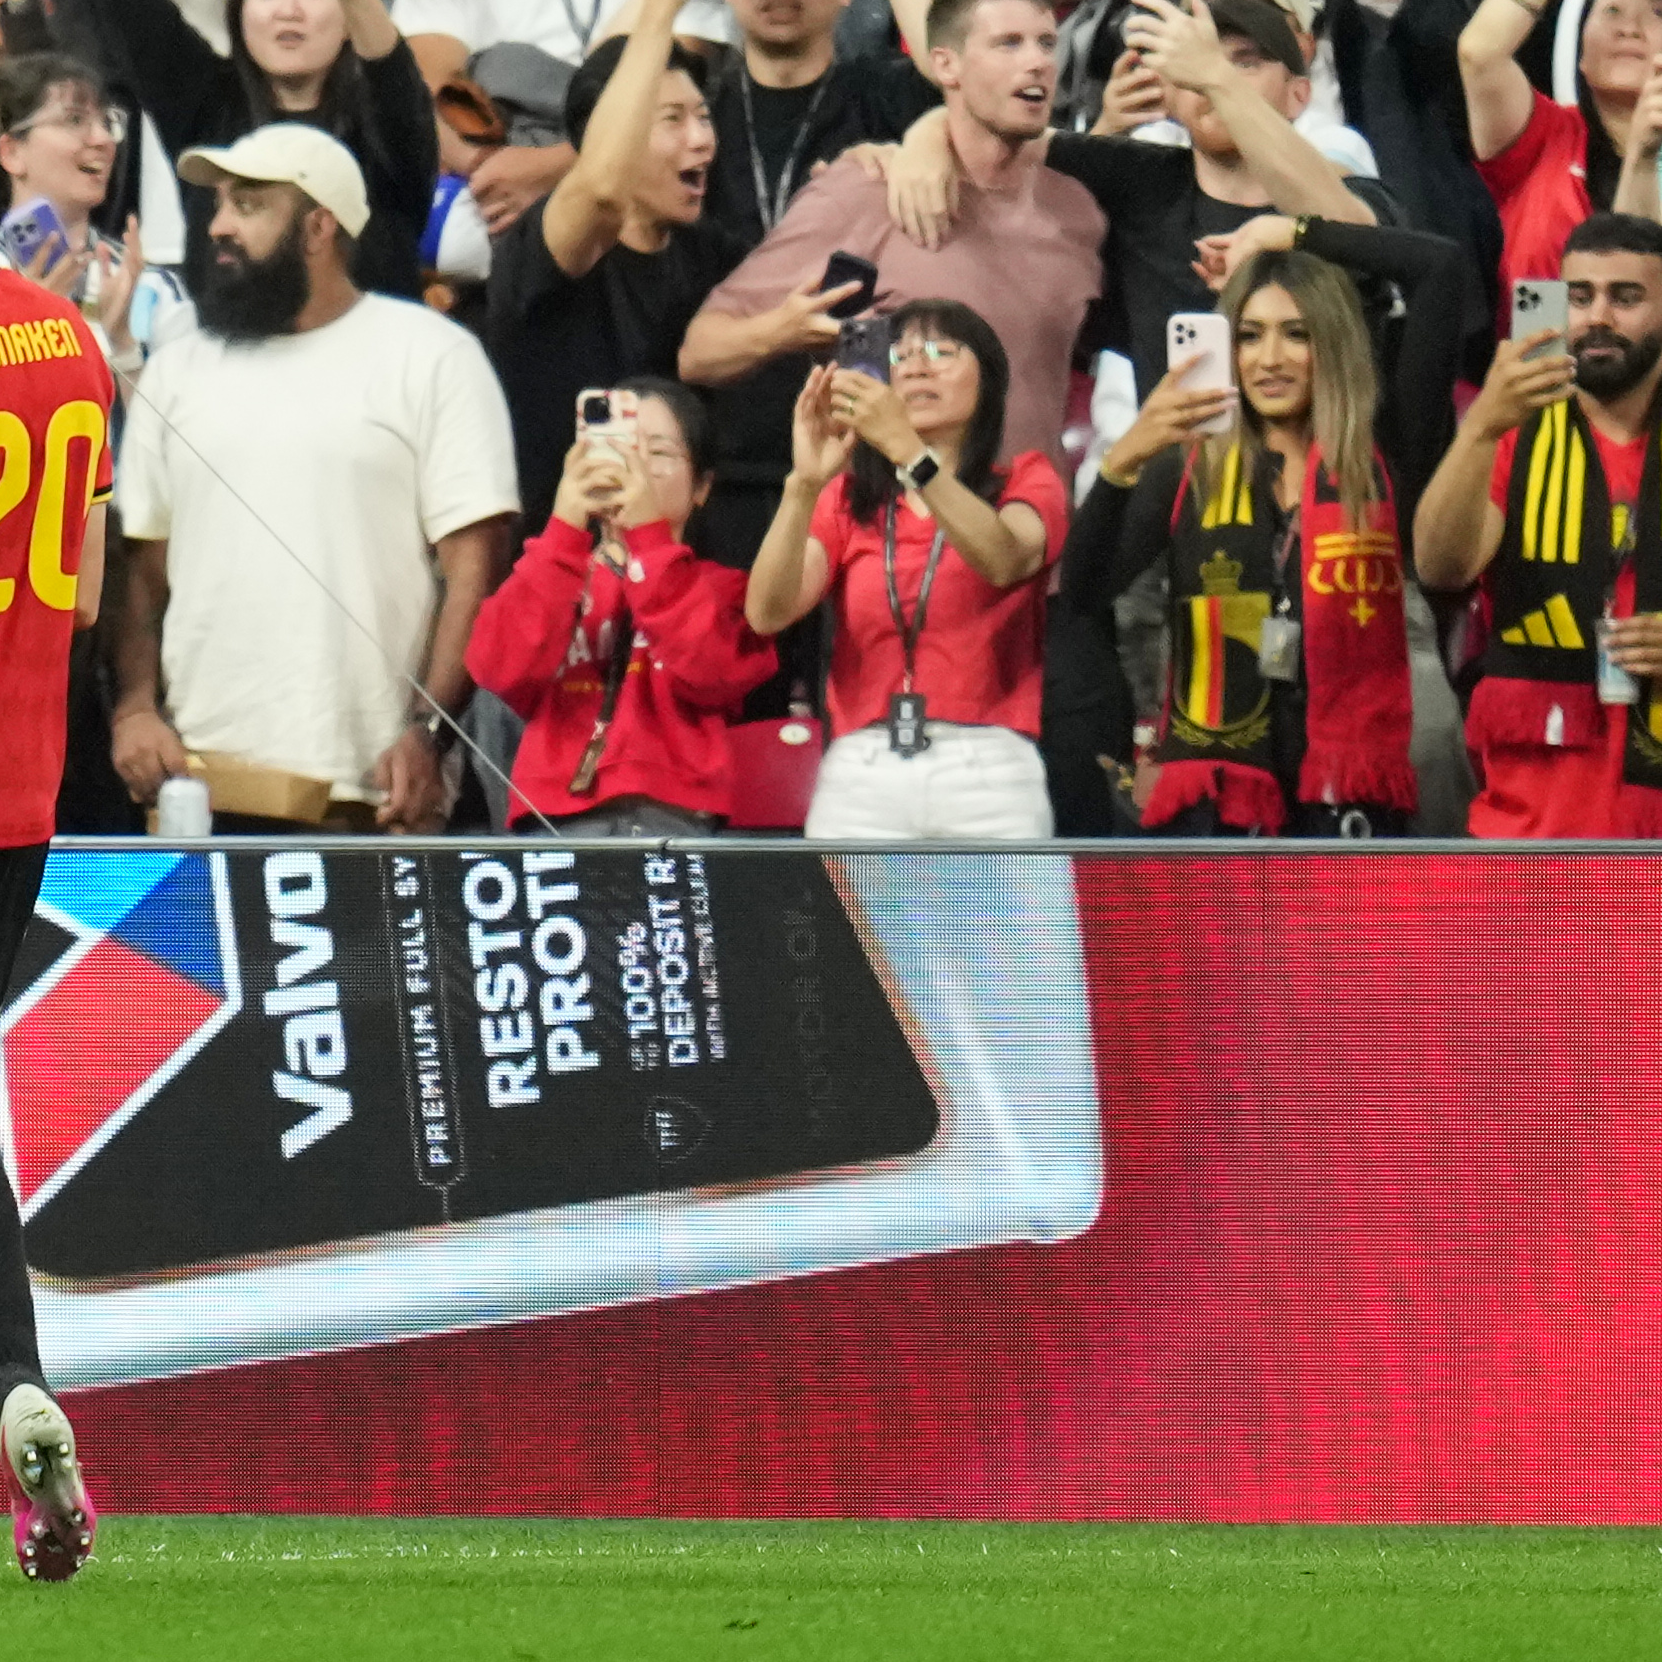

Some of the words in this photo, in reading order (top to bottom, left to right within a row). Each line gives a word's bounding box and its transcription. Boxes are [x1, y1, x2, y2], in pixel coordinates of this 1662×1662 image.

[643, 851, 677, 885] R
[398, 907, 432, 994] FULL
[459, 851, 543, 1109] RESTO
[617, 921, 659, 1039] 100%
[648, 892, 701, 1066] DEPOSIT
[408, 1004, 452, 1167] PREMIUM
